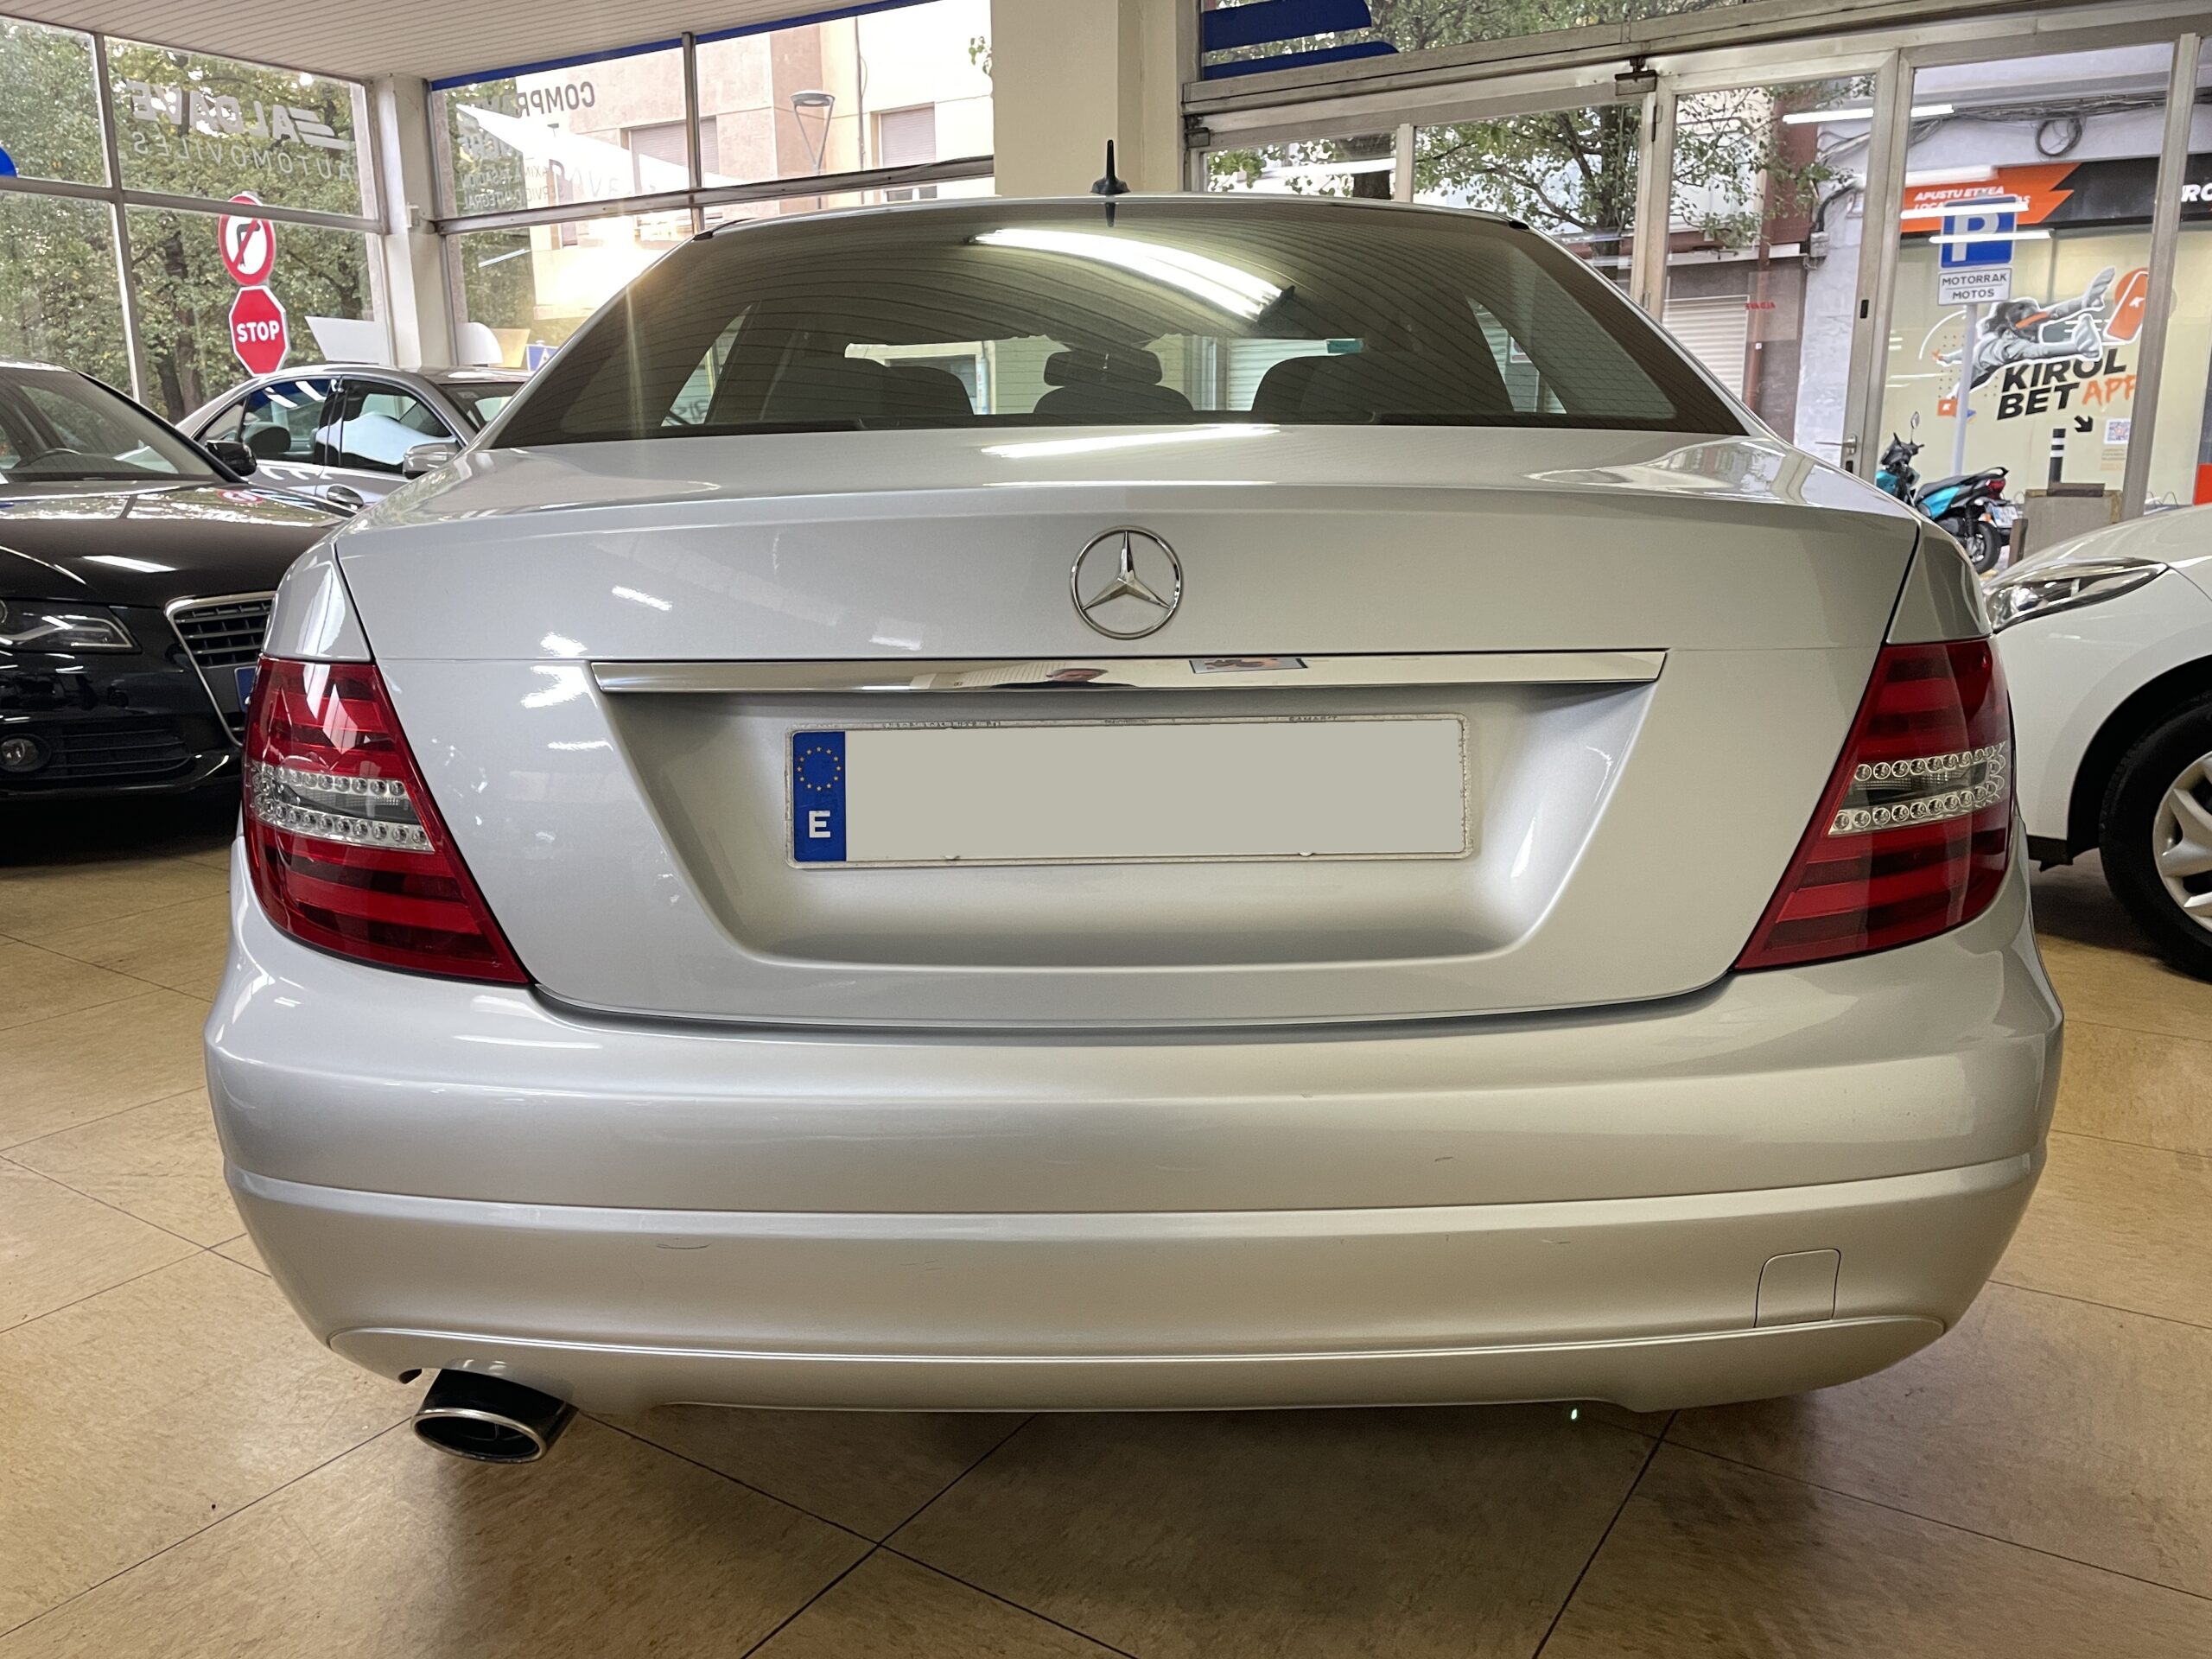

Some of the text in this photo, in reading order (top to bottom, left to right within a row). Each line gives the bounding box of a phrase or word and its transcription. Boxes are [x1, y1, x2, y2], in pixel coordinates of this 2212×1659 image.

[1914, 188, 1963, 201] APUSTU
[1951, 210, 1999, 262] P
[1942, 273, 2007, 286] MOTORRAK
[1952, 288, 1995, 300] MOTOS
[236, 320, 281, 343] STOP
[2002, 348, 2126, 392] KIROL
[1997, 382, 2080, 420] BET
[808, 810, 831, 838] E
